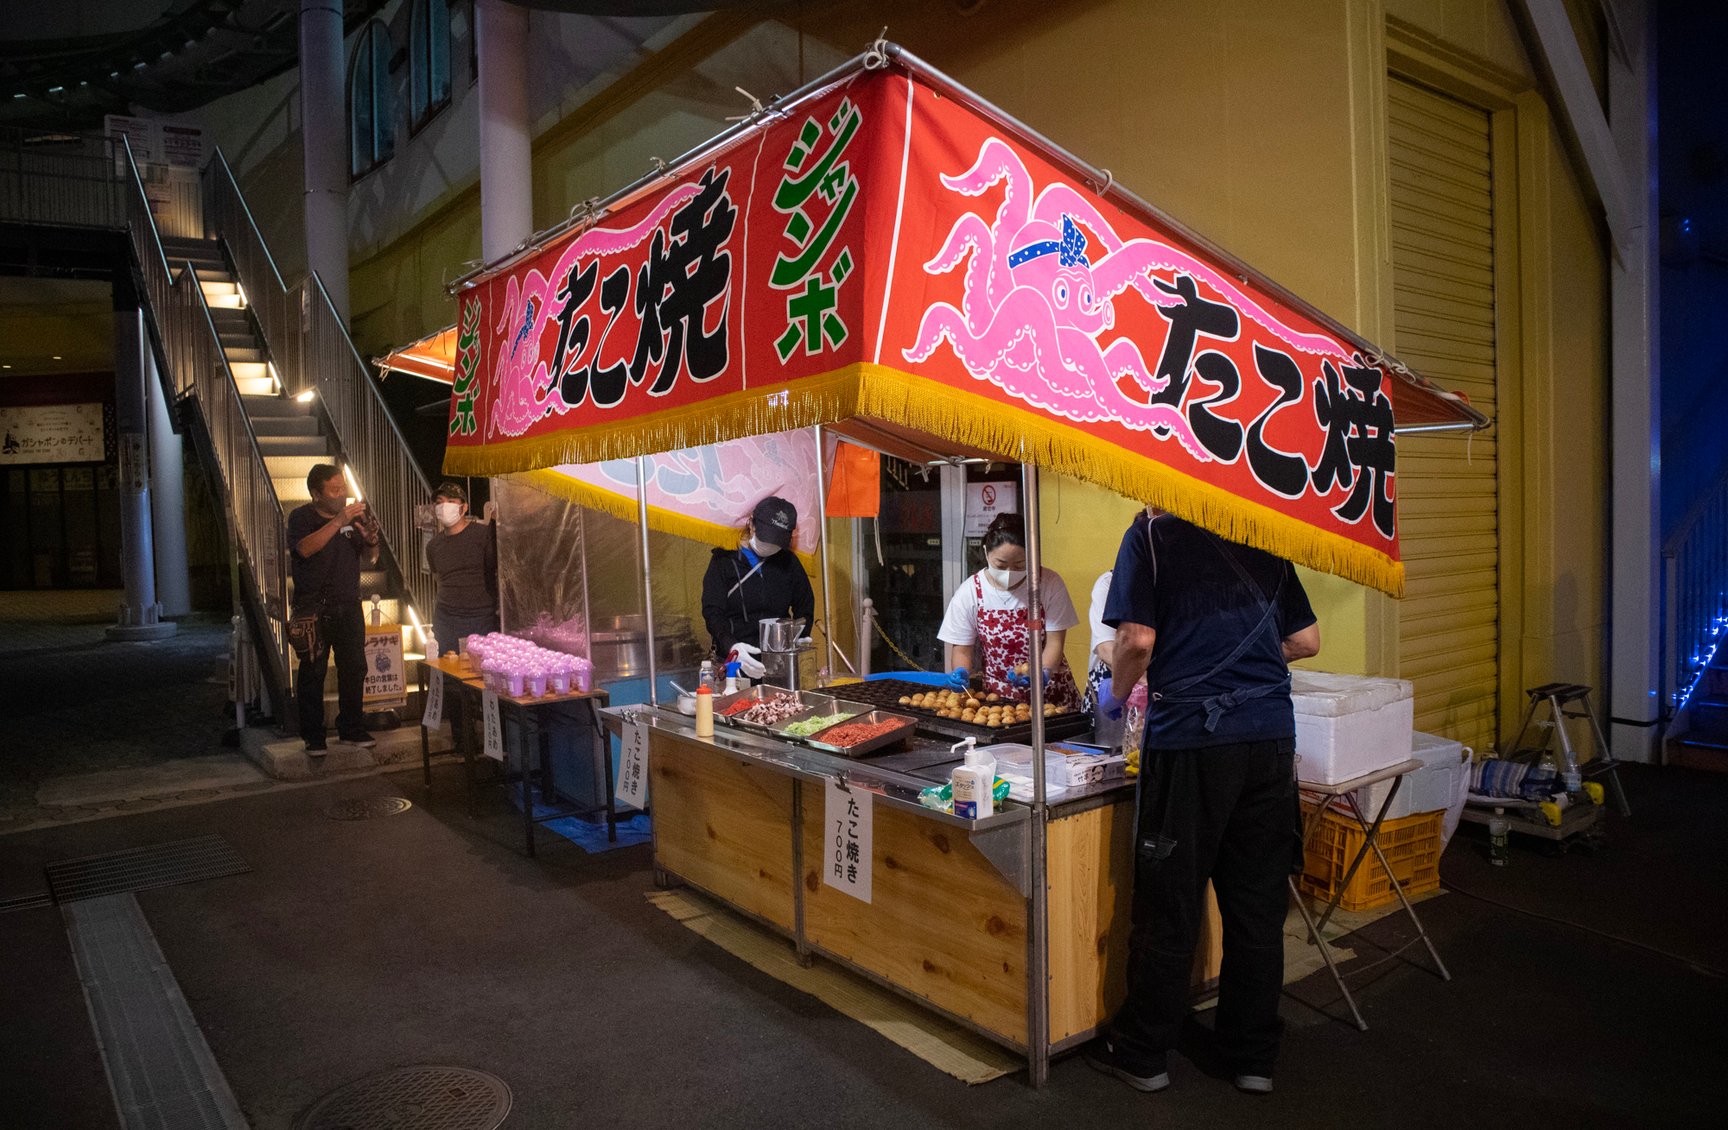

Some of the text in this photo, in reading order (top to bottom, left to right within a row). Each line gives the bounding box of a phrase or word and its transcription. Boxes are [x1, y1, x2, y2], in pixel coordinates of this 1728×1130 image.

[769, 97, 863, 366] ジャンボ
[547, 165, 738, 412] たこ焼
[450, 294, 482, 437] ジャンボ
[1149, 275, 1396, 540] たこ焼
[22, 436, 94, 448] ガシャポンのデパート
[364, 674, 399, 685] 本日の営業は
[365, 683, 403, 695] 終了しました。
[622, 747, 632, 793] 700円
[630, 729, 642, 796] たこ焼き
[834, 819, 843, 879] 700円
[846, 797, 860, 885] たこ焼き
